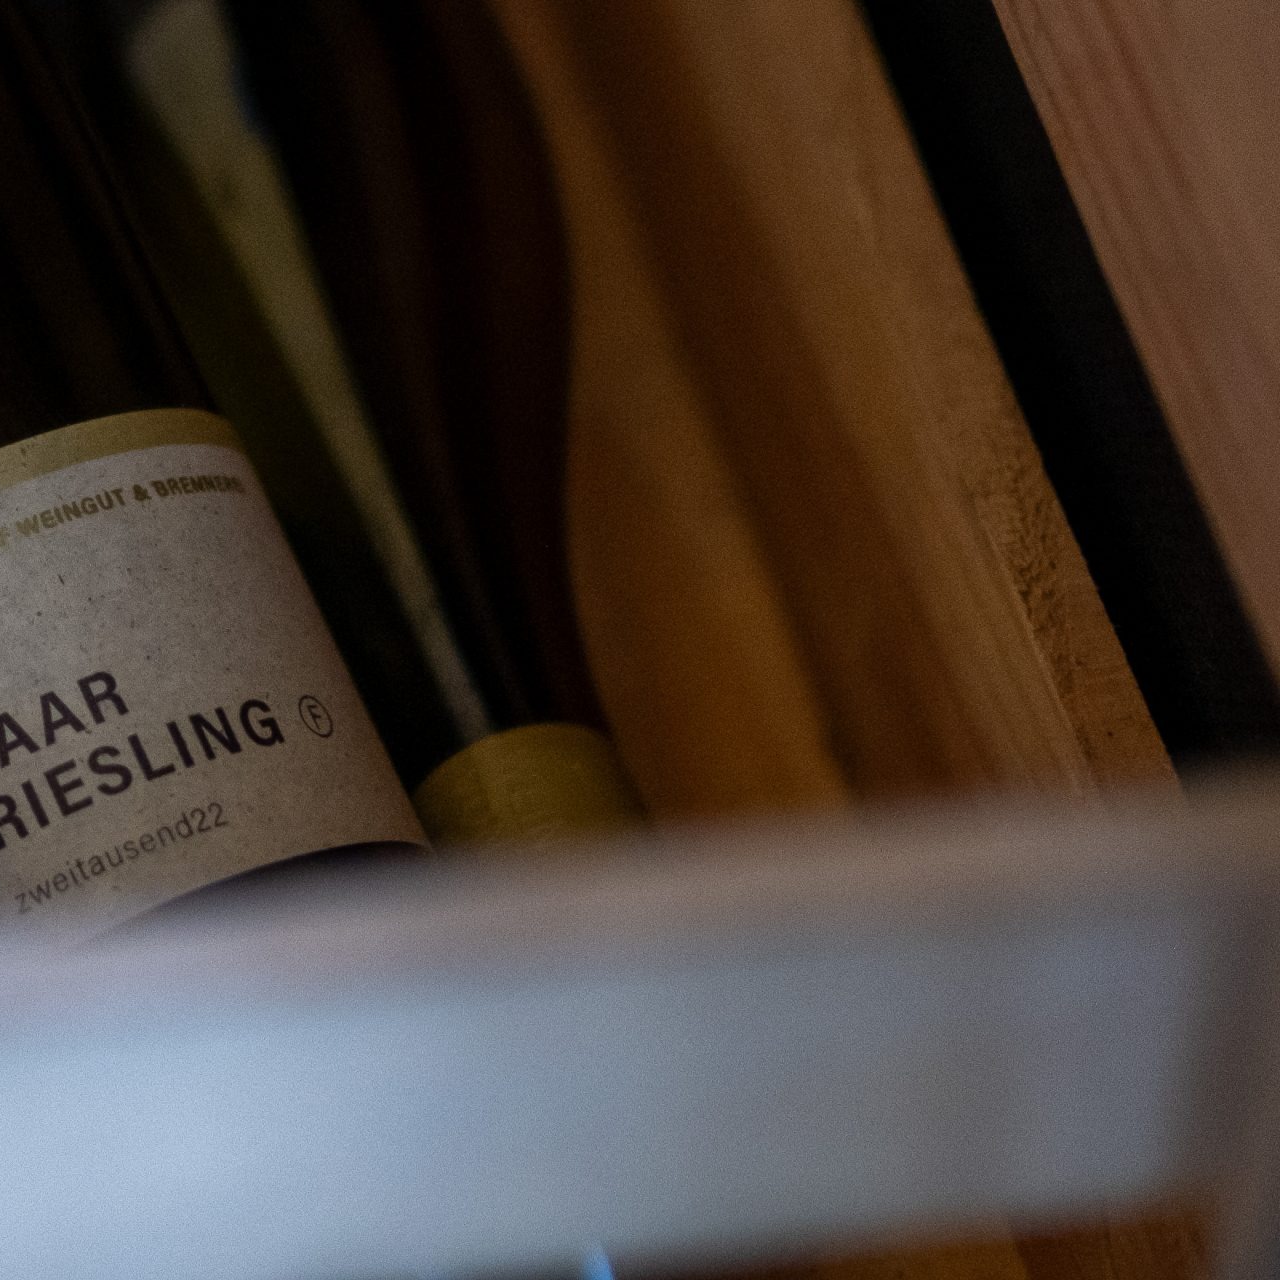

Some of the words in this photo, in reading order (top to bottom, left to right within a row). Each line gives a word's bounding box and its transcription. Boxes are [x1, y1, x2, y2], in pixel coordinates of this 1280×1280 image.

[16, 488, 126, 539] WEINGUT
[132, 483, 152, 502] &
[14, 801, 230, 915] zweitausend22
